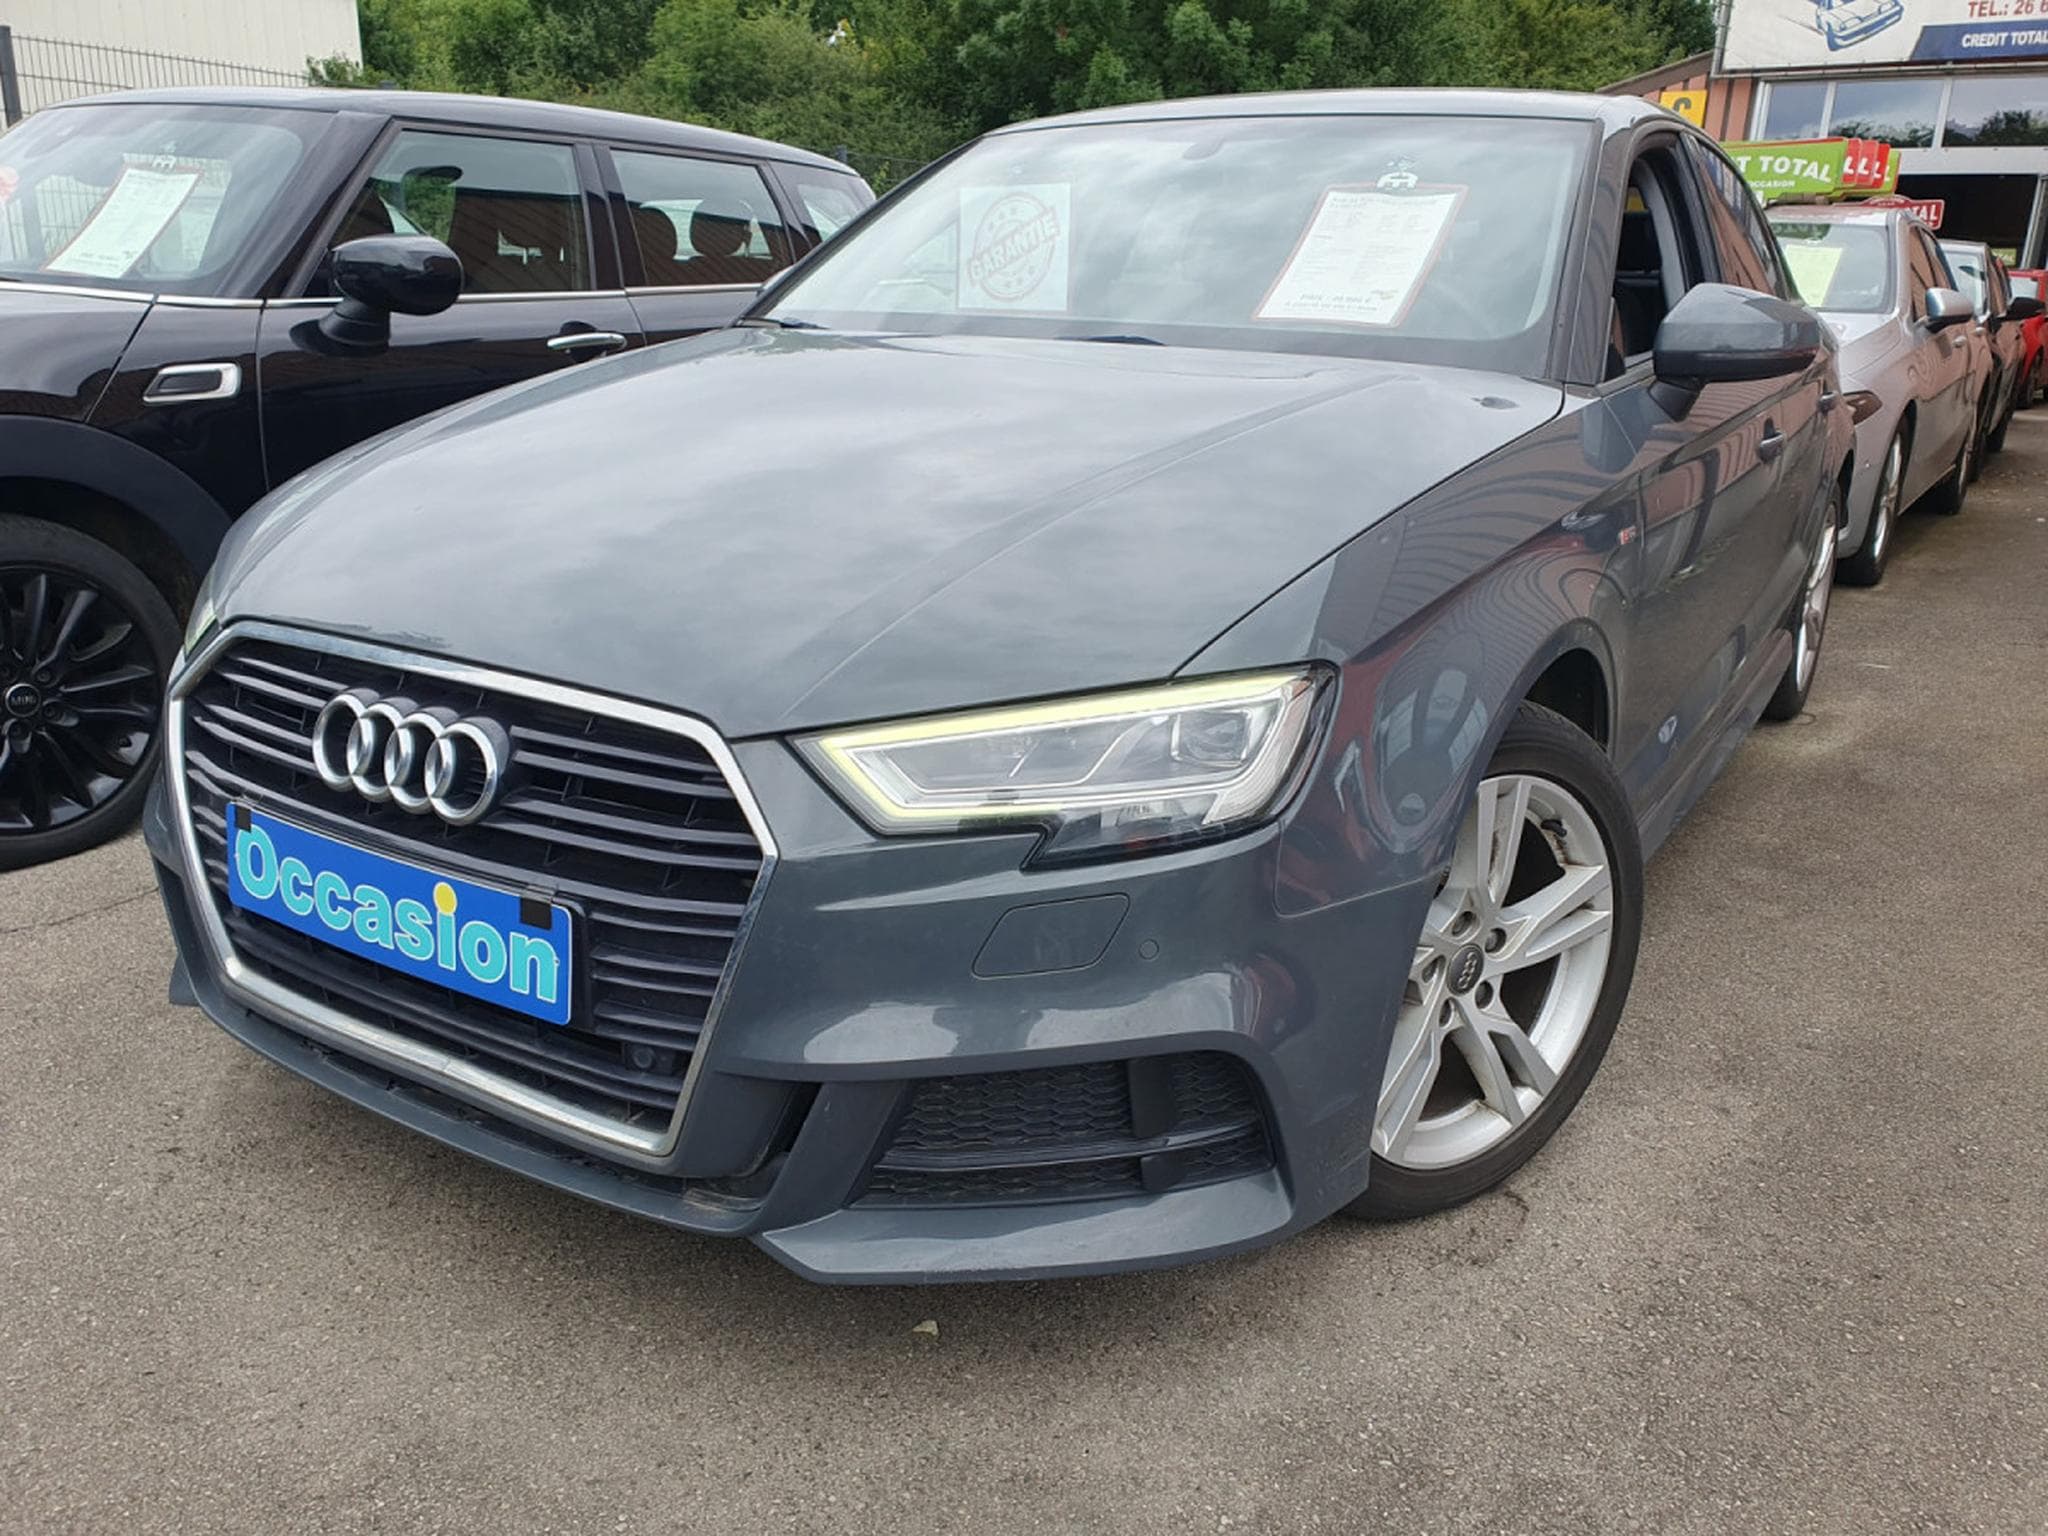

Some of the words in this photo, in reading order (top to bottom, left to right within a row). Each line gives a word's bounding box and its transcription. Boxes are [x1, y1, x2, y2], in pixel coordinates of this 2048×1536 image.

[1962, 32, 2008, 48] CREDIT
[1759, 155, 1832, 183] TOTAL
[235, 824, 560, 1004] Occasion
